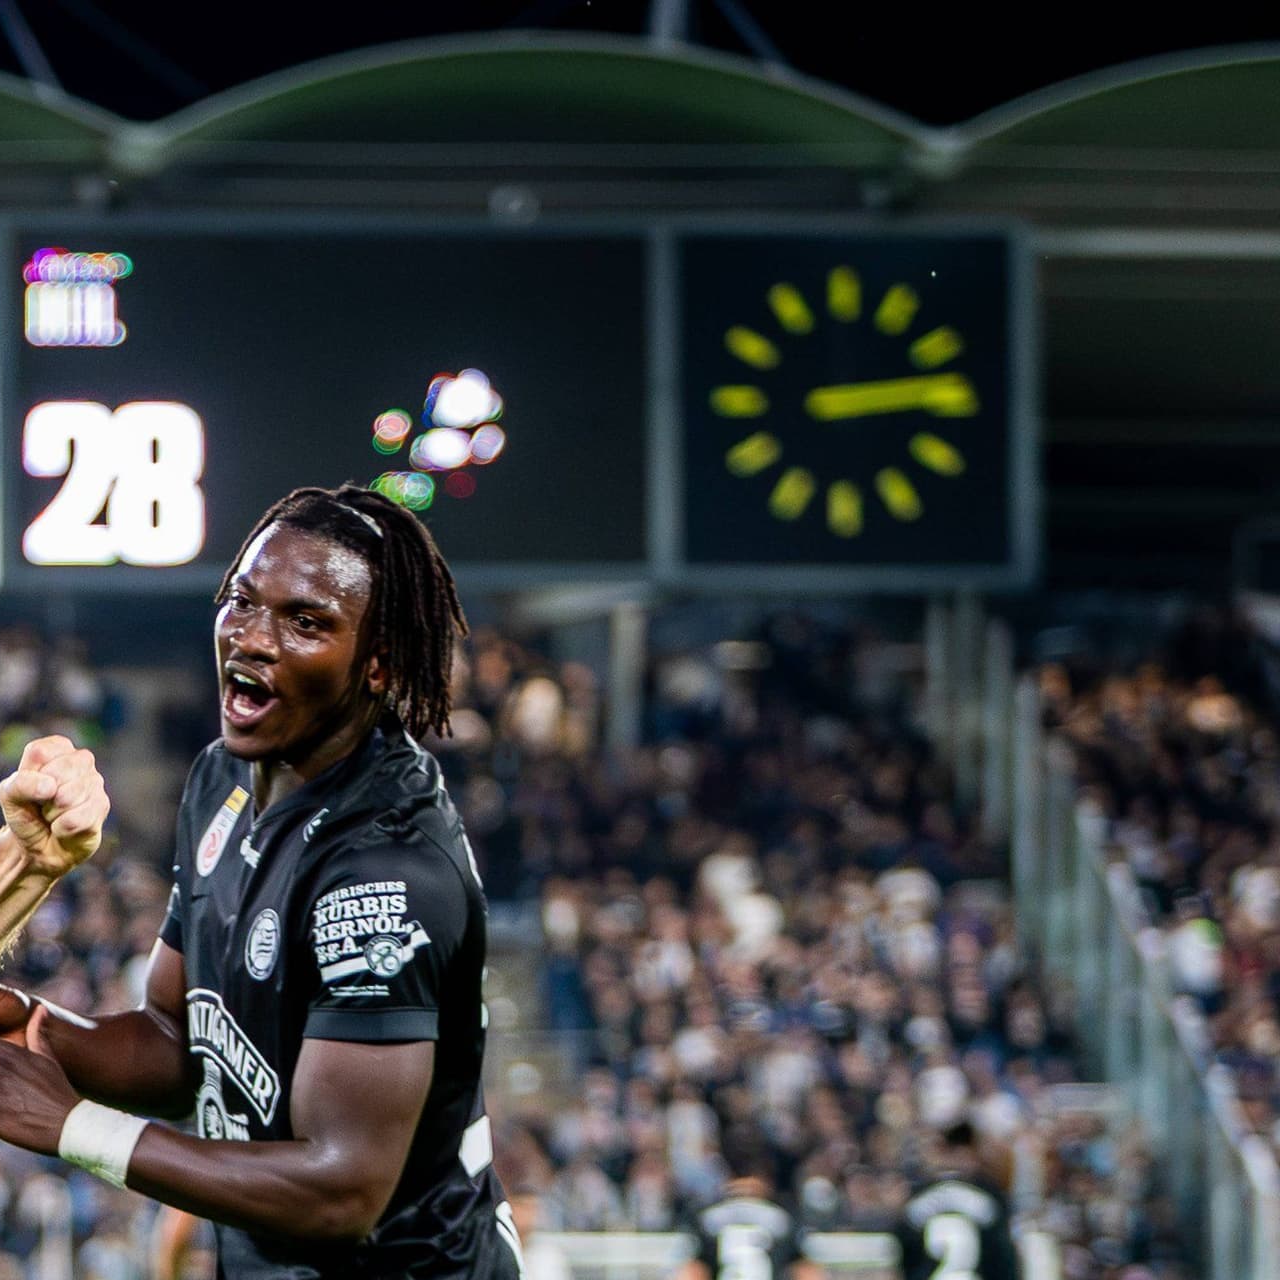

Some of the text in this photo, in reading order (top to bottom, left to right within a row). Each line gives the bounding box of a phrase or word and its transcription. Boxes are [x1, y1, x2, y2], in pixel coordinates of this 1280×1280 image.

[23, 402, 204, 566] 28
[313, 895, 408, 928] KÜRBIS
[188, 1001, 274, 1111] NTIGAMER
